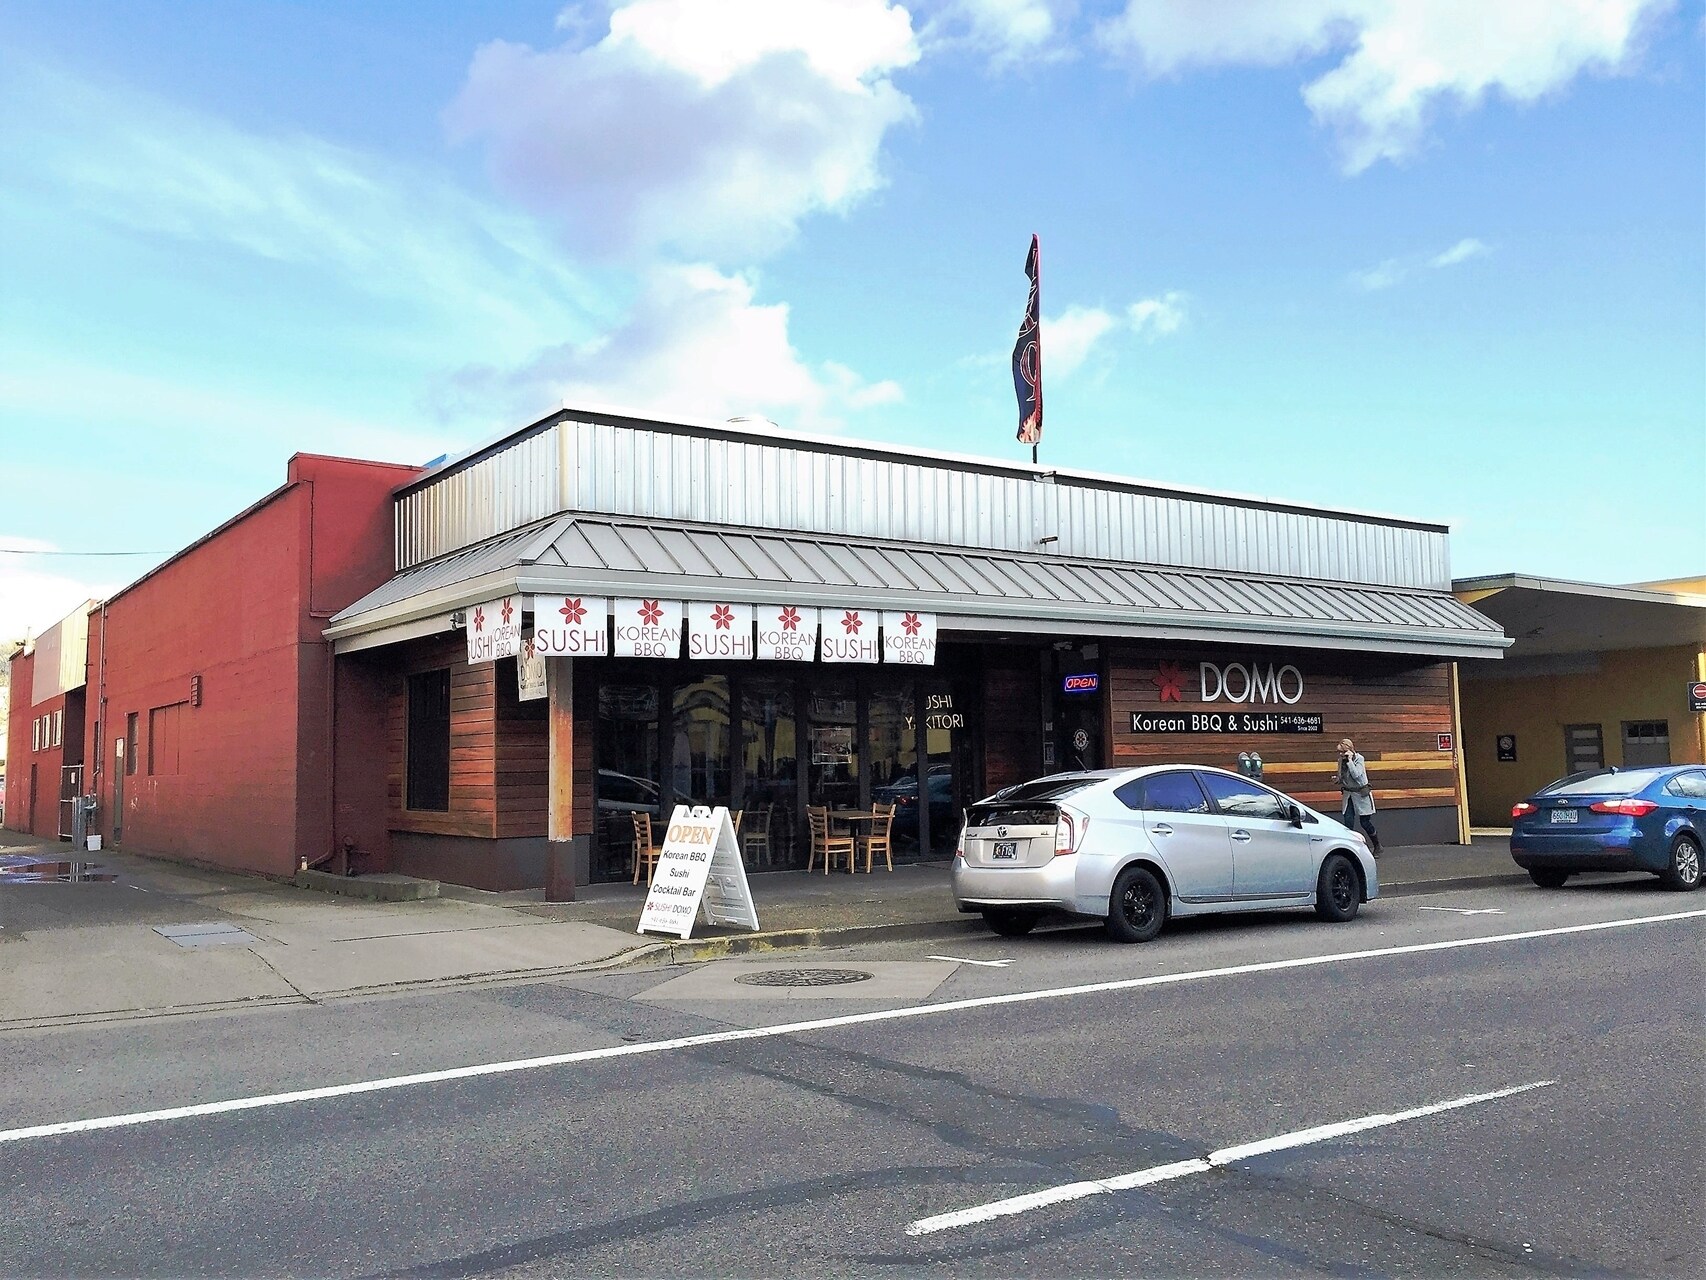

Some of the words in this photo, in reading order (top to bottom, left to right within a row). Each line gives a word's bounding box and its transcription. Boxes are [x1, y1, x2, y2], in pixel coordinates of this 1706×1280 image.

[536, 629, 606, 652] SUSHI
[616, 626, 681, 642] KOREAN
[759, 631, 816, 647] KOREAN
[496, 641, 512, 658] BBQ
[634, 643, 666, 658] BBQ
[690, 633, 751, 656] SUSHI
[823, 637, 877, 660] SUSHI
[885, 635, 936, 651] KOREAN
[774, 646, 804, 661] BBQ
[899, 650, 925, 664] BBQ
[1066, 677, 1097, 689] OPEN
[1200, 662, 1304, 704] DOMO
[926, 694, 953, 710] USHI
[905, 713, 964, 730] YKITORI
[1133, 713, 1185, 731] Korean
[1191, 714, 1222, 732] BBQ
[1228, 714, 1238, 731] &
[1243, 714, 1278, 731] Sushi
[668, 825, 716, 845] OPEN
[663, 850, 689, 860] Korean
[689, 851, 707, 862] BBQ
[670, 867, 690, 878] Sushi
[653, 883, 682, 895] Cocktail
[682, 887, 696, 897] Bar
[672, 904, 692, 914] DOMO
